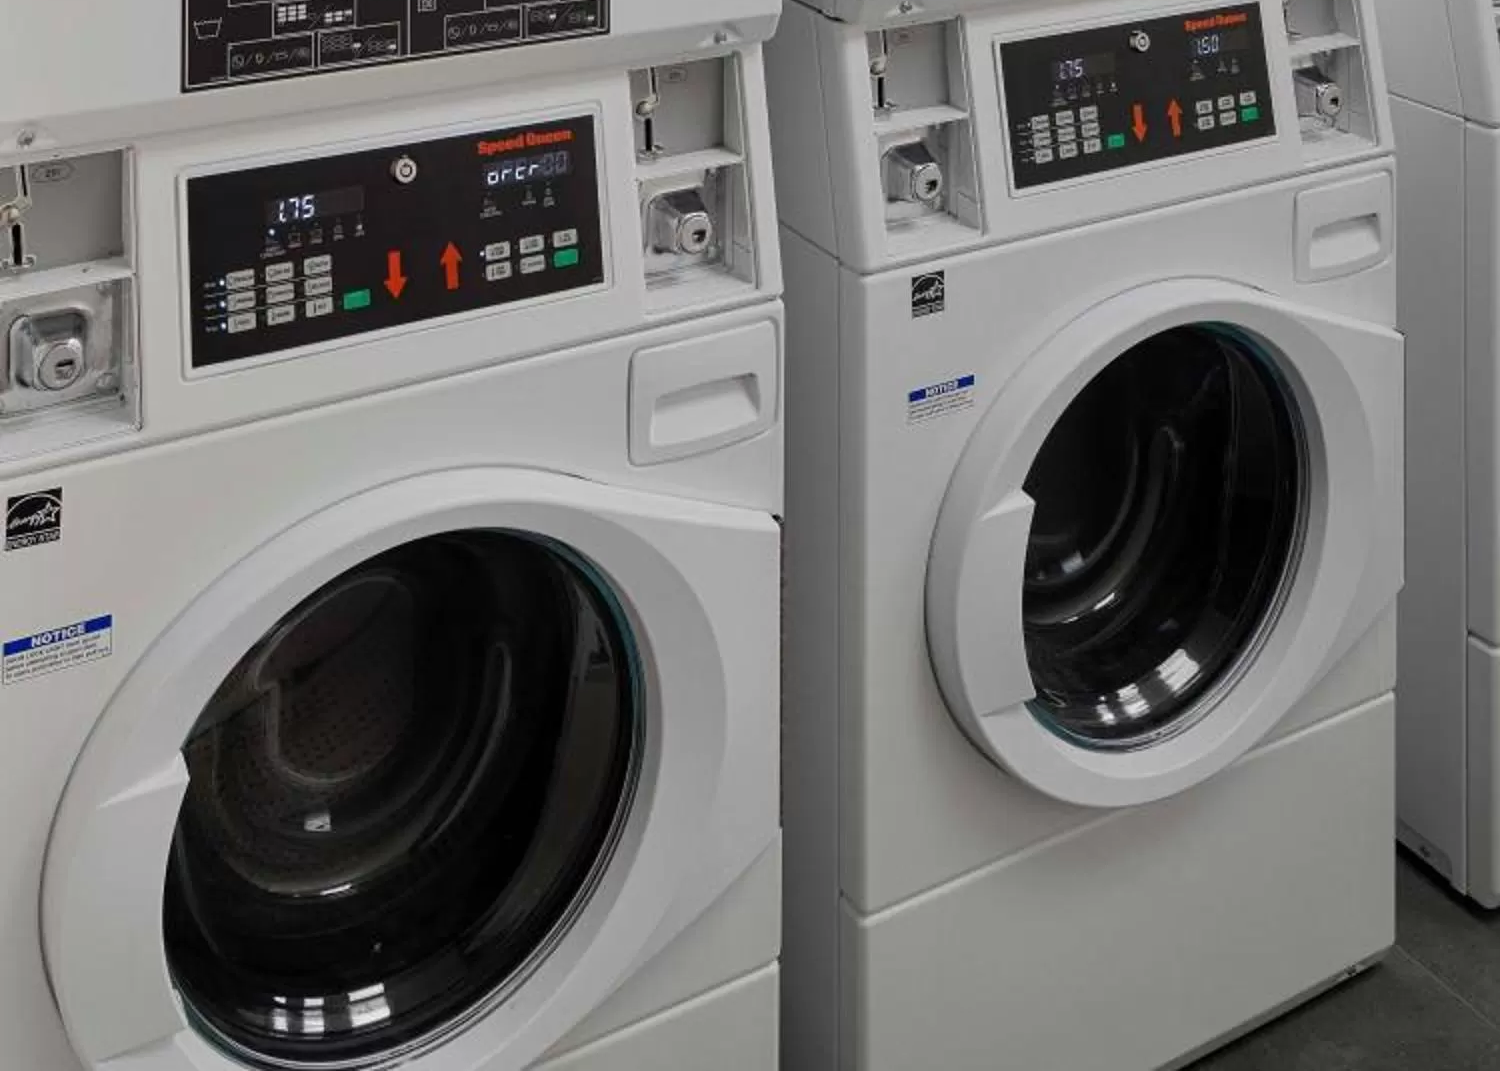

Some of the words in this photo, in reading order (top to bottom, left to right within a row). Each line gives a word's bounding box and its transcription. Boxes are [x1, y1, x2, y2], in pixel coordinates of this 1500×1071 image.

[477, 137, 525, 155] Speed
[526, 130, 573, 147] Queen
[31, 621, 86, 649] NOTICE
